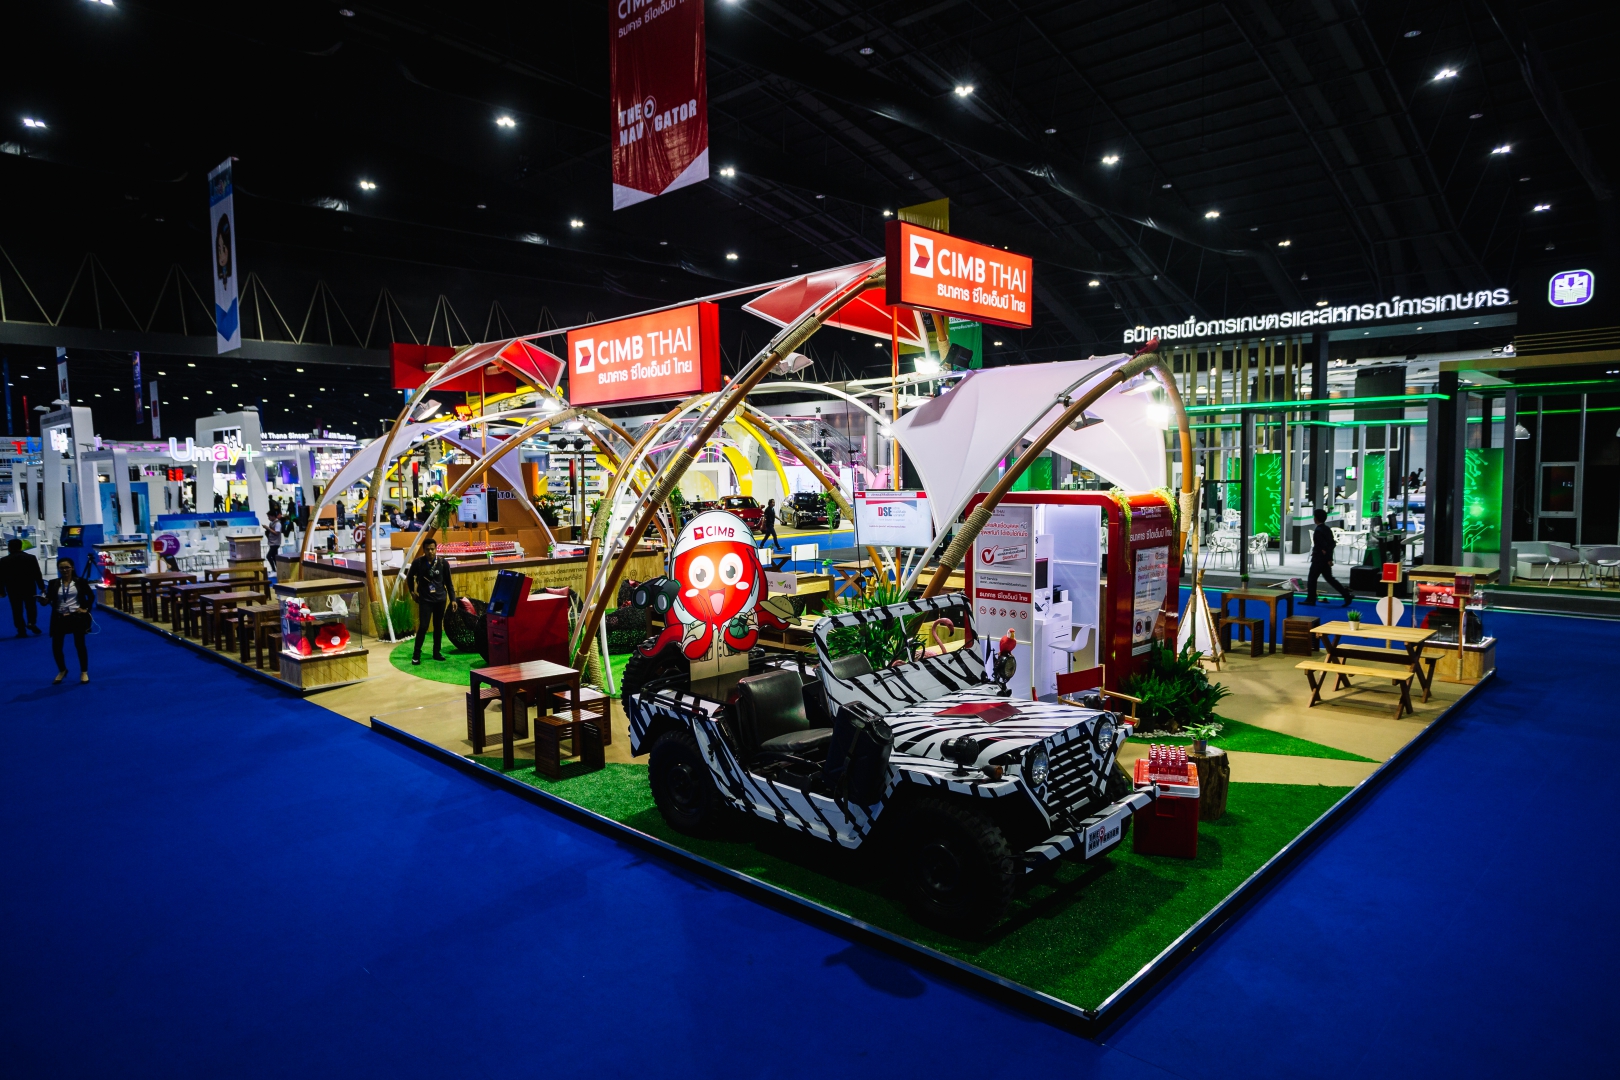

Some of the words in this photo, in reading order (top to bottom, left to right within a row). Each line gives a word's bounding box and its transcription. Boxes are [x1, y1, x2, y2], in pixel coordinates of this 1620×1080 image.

[618, 0, 653, 19] CIM
[620, 103, 642, 127] THE
[620, 122, 644, 147] NAV
[655, 99, 697, 132] GATOR
[937, 248, 986, 283] CIMB
[989, 261, 1026, 293] THAI
[937, 283, 970, 301] ธนาคาร
[972, 287, 1009, 309] ซีไอเอ็มบี
[1011, 294, 1026, 313] ไทย
[597, 335, 644, 365] CIMB
[647, 326, 692, 357] THAI
[598, 369, 629, 385] ธนาคาร
[630, 359, 671, 380] ซีไอเอ็มบี
[673, 357, 693, 374] ไทย
[168, 436, 260, 466] Umay+
[878, 506, 893, 517] DSE
[705, 525, 735, 538] CIMB
[1088, 828, 1100, 839] THE
